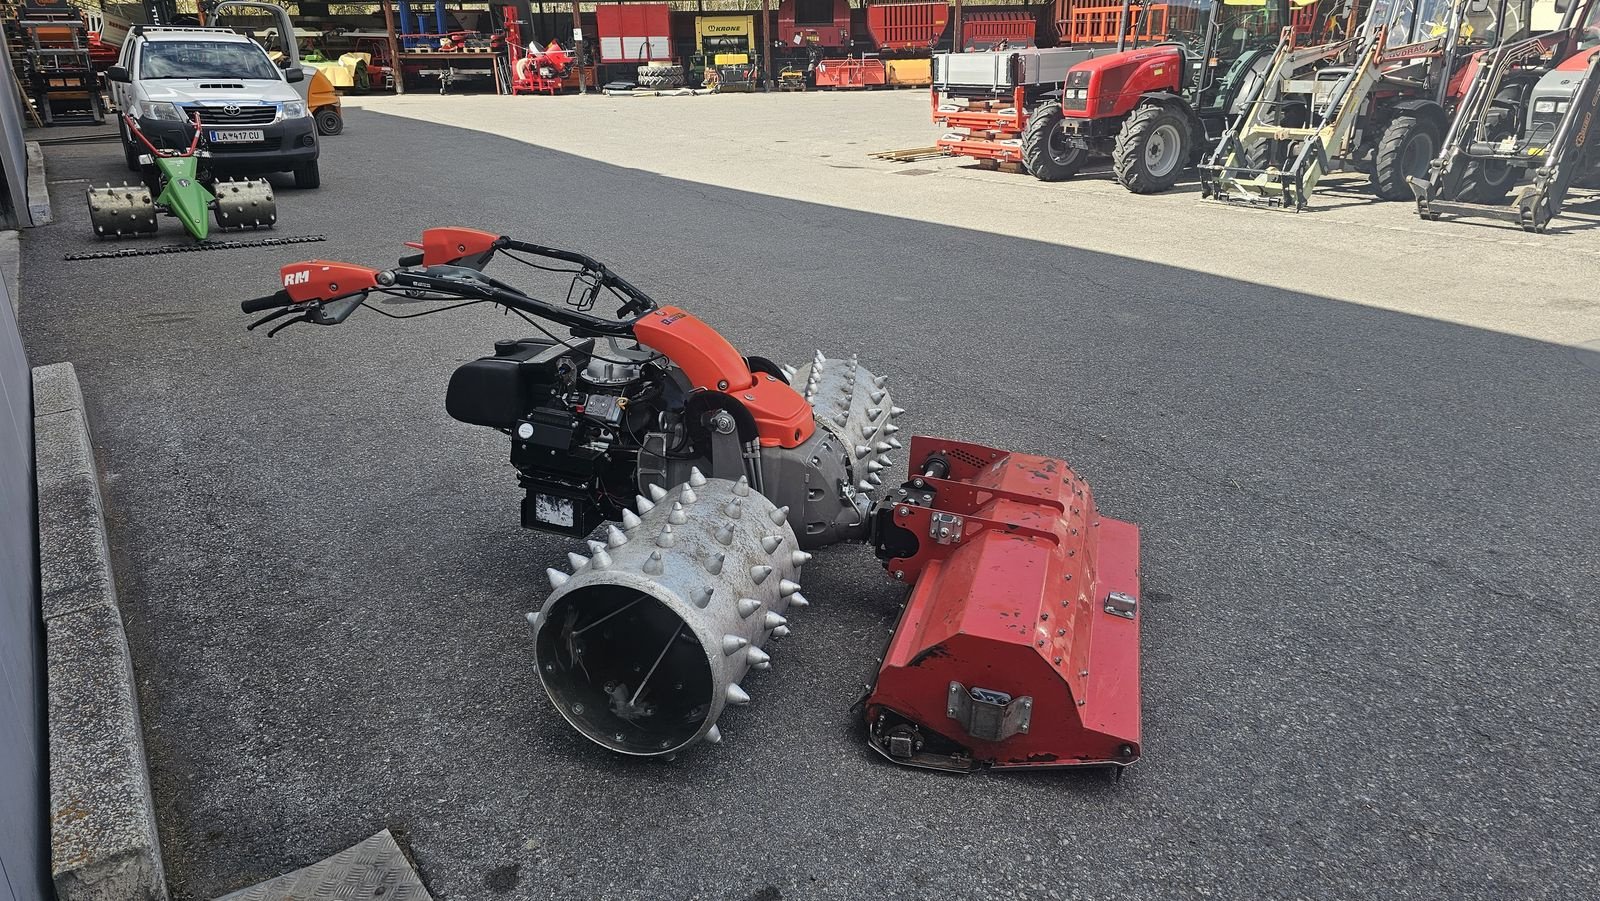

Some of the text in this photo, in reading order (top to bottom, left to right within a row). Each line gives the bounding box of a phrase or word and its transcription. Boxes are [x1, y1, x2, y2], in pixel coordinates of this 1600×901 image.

[217, 131, 260, 141] LA 417 CU
[284, 270, 310, 287] RM
